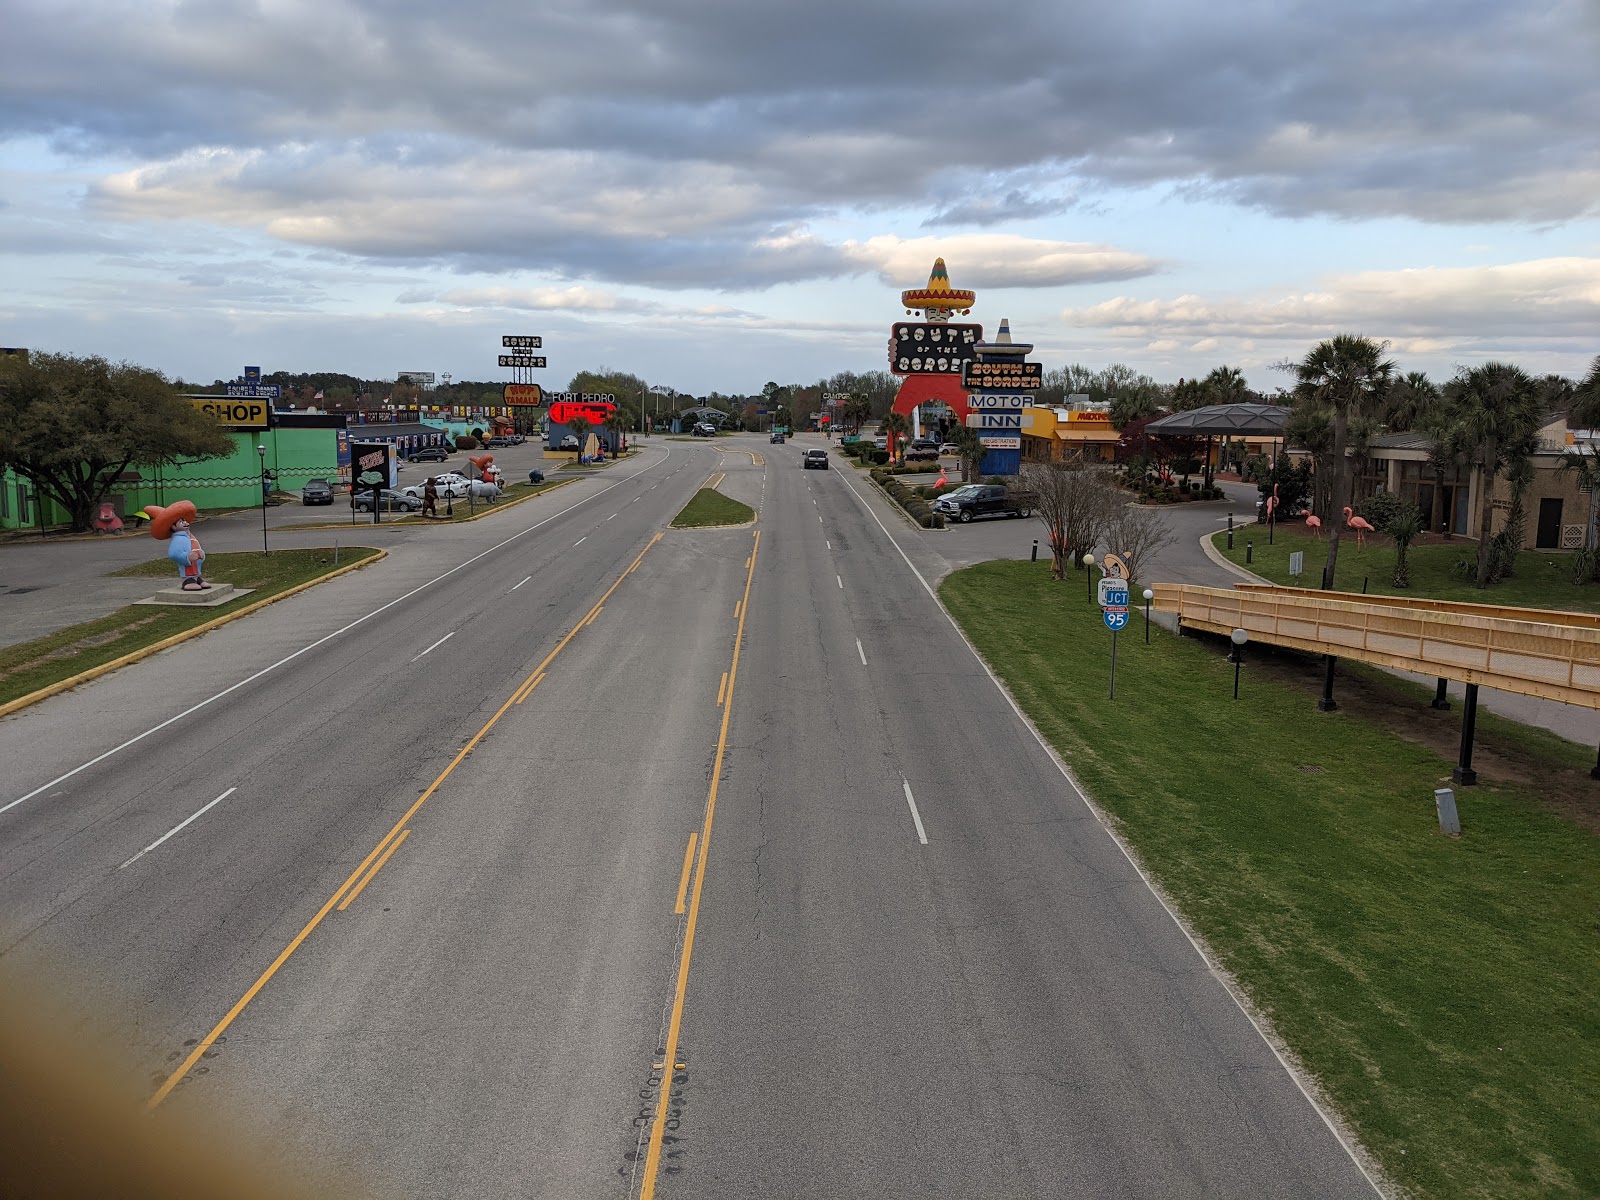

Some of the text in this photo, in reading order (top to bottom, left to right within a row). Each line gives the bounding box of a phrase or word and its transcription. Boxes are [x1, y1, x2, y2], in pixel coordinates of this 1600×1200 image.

[899, 327, 975, 344] SOUTH
[503, 337, 540, 347] SOUTH
[937, 346, 958, 354] THE
[499, 356, 545, 367] BORDER
[971, 363, 1037, 375] SOUTH OF
[967, 376, 1041, 388] THE BORDER
[505, 396, 538, 405] TAMALE
[552, 392, 615, 404] FORT PEDRO
[971, 395, 1034, 408] MOTOR
[202, 404, 262, 421] SHOP
[982, 415, 1021, 427] INN
[1107, 592, 1128, 604] JCT
[1108, 614, 1124, 626] 95
